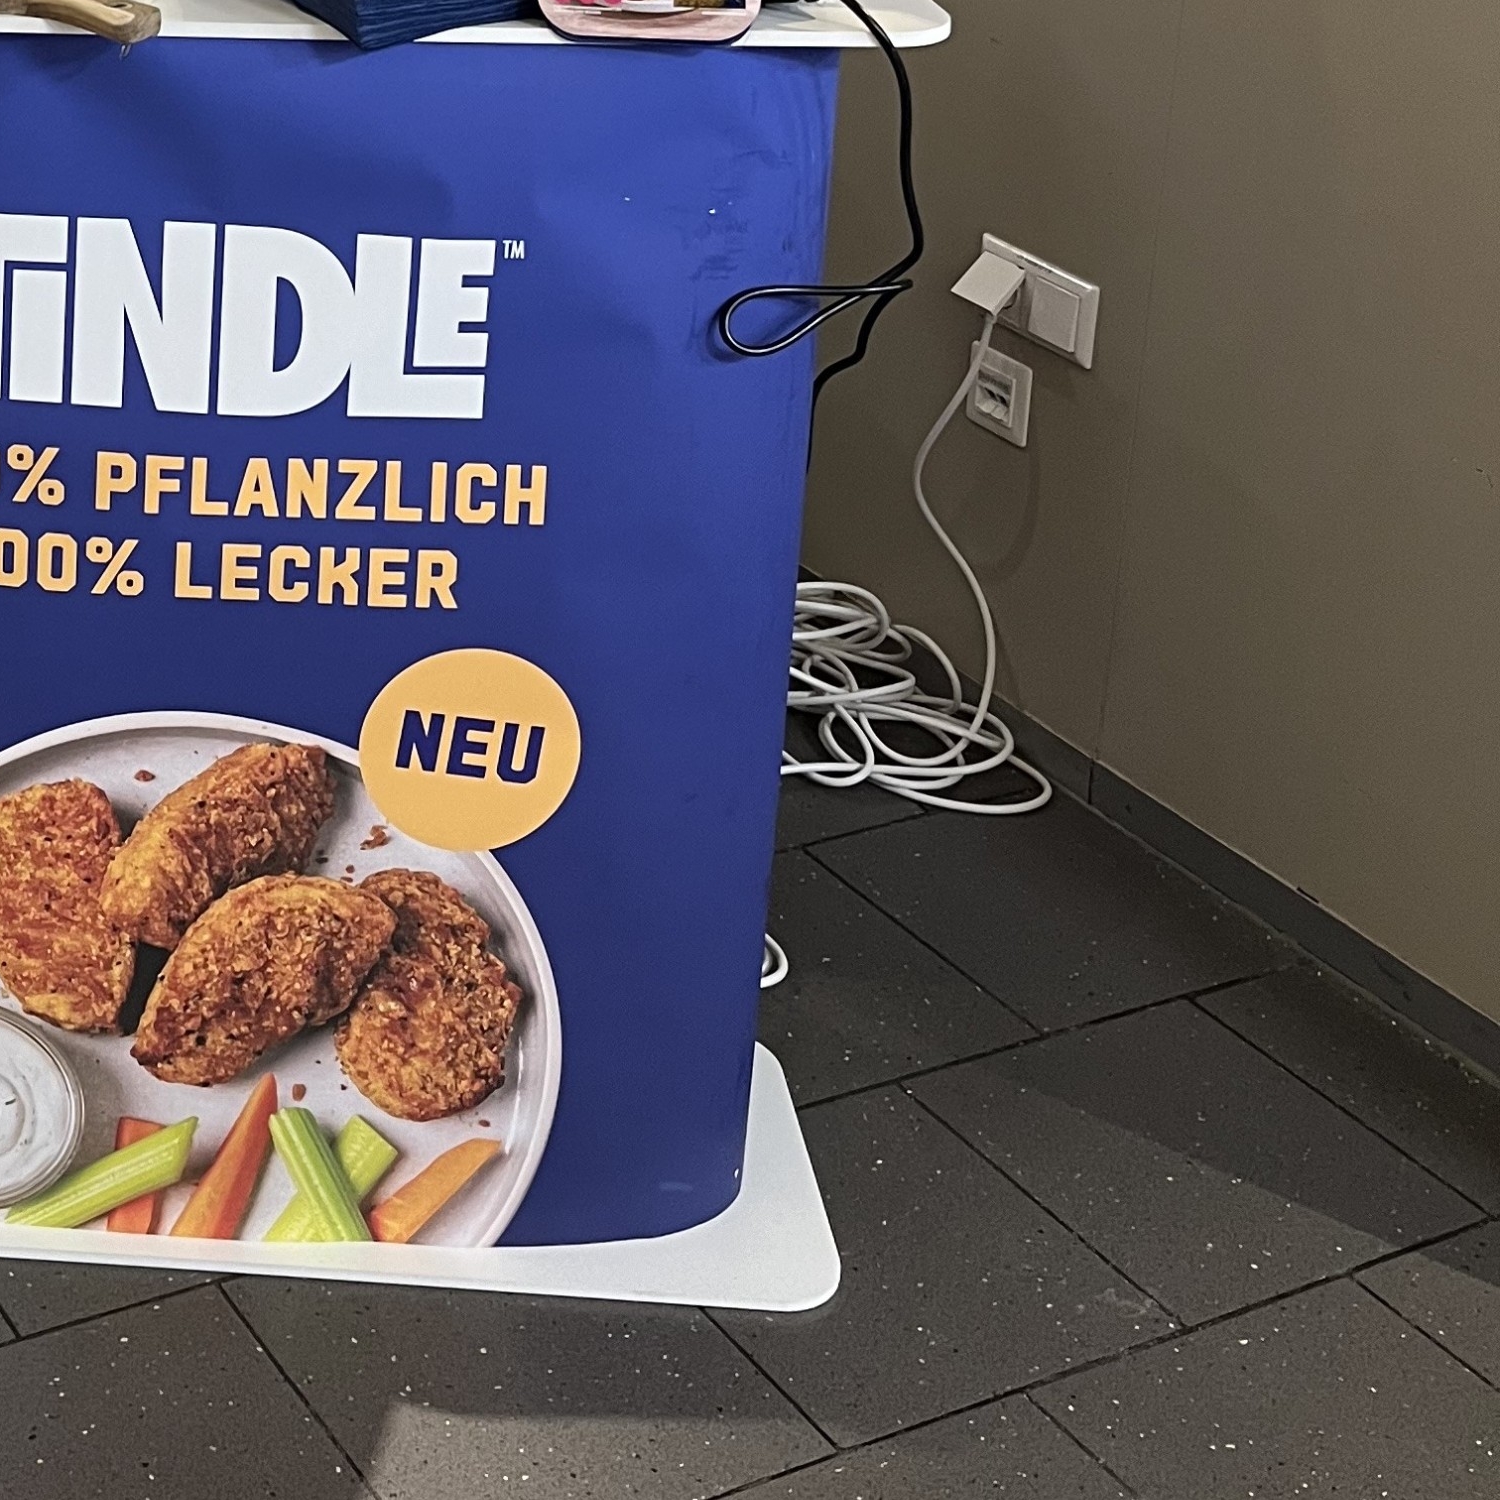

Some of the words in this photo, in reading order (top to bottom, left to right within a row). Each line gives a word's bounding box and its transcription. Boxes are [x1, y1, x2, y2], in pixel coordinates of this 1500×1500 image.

[94, 450, 548, 526] PFLANZLICH
[174, 541, 458, 610] LECKER
[395, 709, 545, 784] NEU
